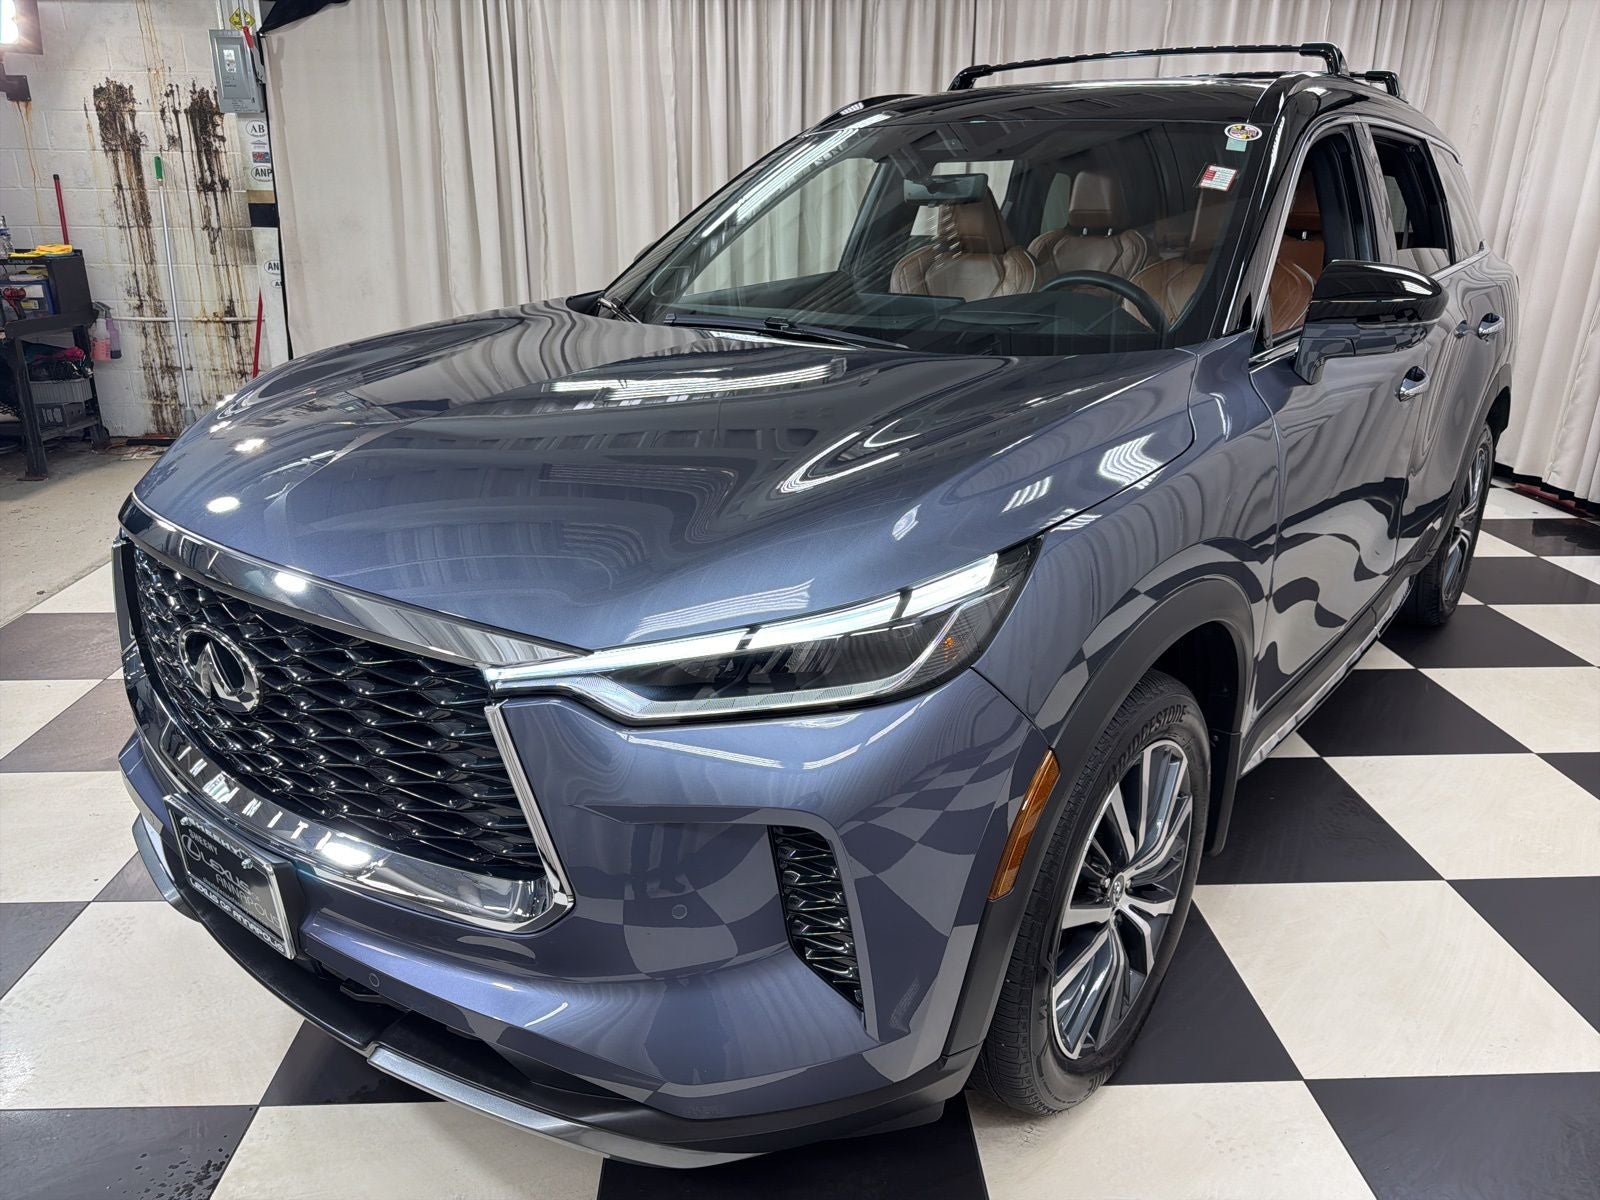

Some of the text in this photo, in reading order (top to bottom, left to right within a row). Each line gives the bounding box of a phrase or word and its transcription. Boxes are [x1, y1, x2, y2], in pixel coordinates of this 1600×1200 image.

[251, 124, 265, 134] AB
[177, 744, 332, 850] ININITI
[188, 828, 218, 855] SHEEHY
[200, 851, 251, 896] LEXUS
[189, 877, 219, 904] LEXUS
[219, 900, 232, 912] OF
[232, 910, 285, 953] ANNAPOLIS
